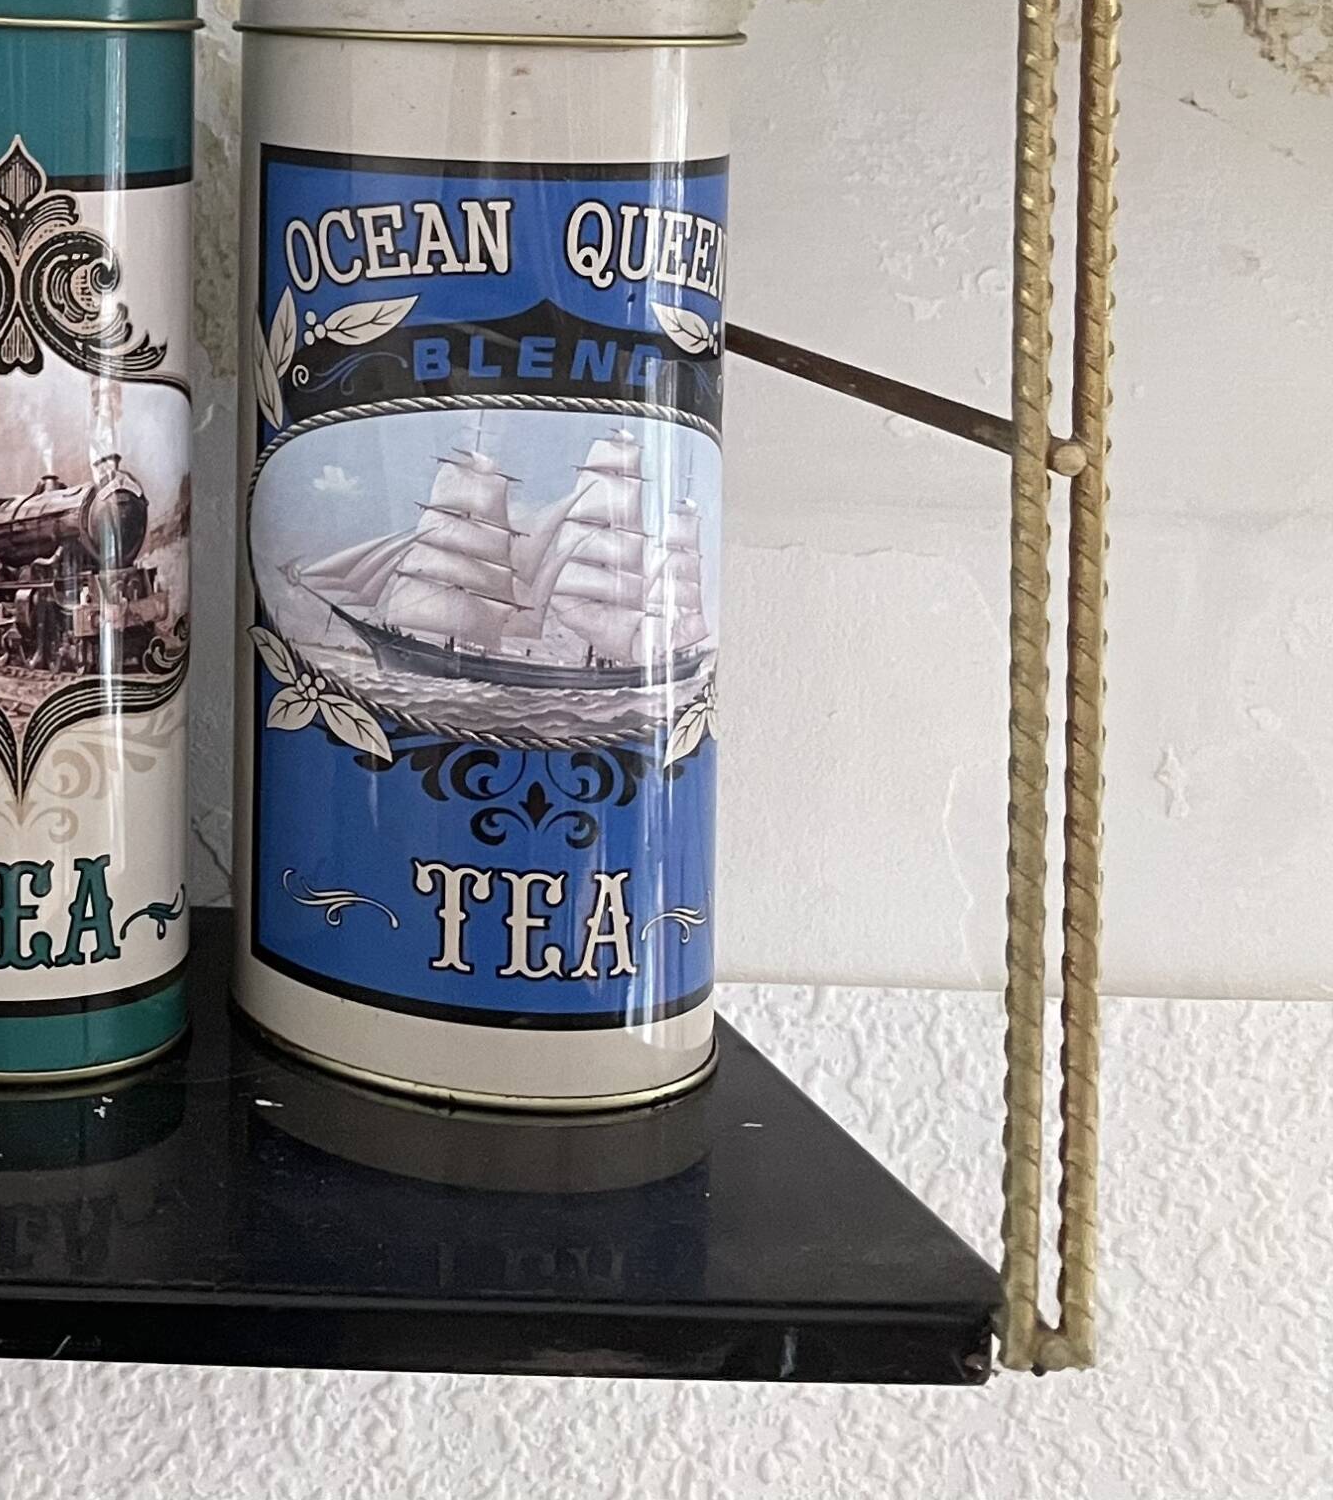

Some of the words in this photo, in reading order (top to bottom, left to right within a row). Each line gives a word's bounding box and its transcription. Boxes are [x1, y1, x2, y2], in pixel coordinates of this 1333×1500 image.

[284, 200, 512, 293] OCEAN
[412, 335, 665, 388] BLEND
[412, 859, 639, 980] TEA
